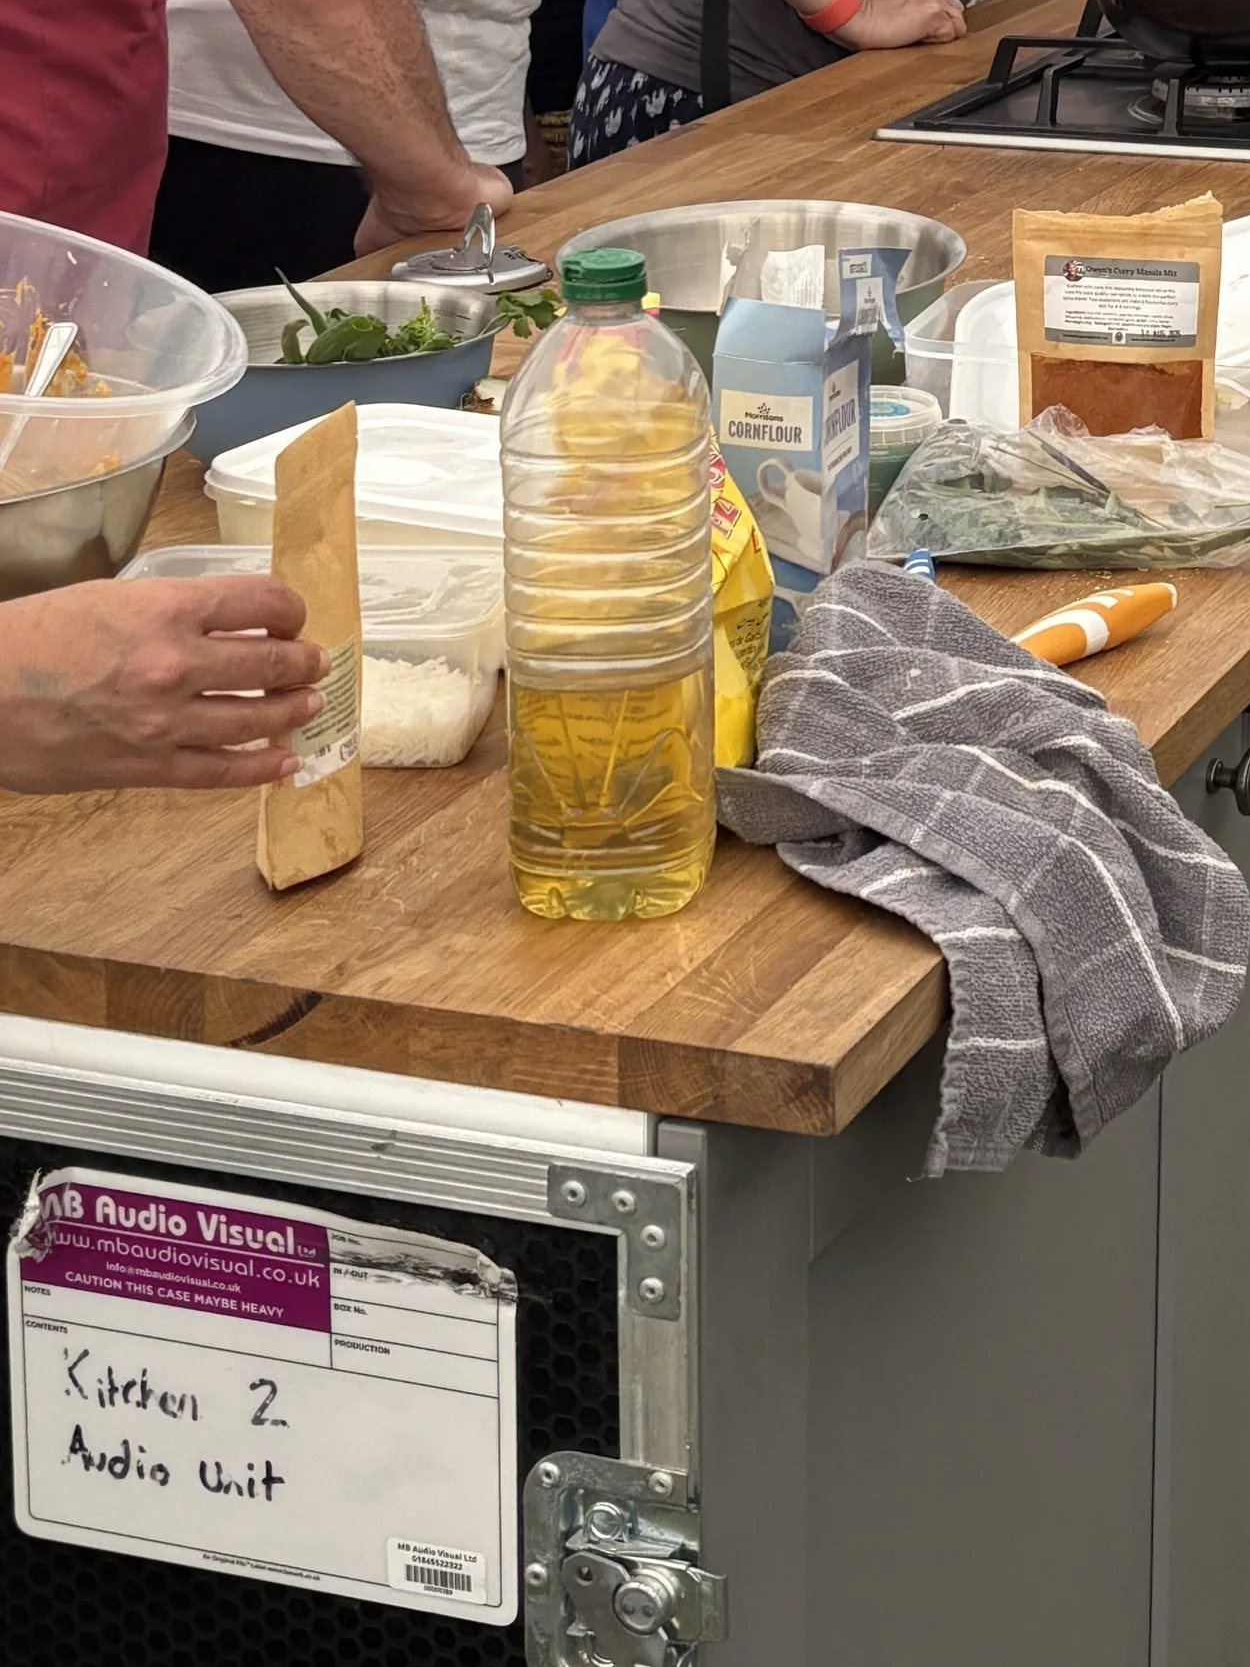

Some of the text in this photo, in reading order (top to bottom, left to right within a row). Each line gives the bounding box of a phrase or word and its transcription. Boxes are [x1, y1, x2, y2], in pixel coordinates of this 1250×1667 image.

[745, 411, 784, 422] Morrisons
[728, 420, 802, 444] CORNFLOUR
[95, 1195, 187, 1237] Audio
[197, 1210, 295, 1255] Visual
[331, 1234, 346, 1242] JOB
[24, 1286, 51, 1296] NOTES
[65, 1271, 284, 1318] CAUTION THIS CASE MAYBE HEAVY
[334, 1303, 351, 1312] BOX
[26, 1320, 68, 1334] CONTENTS
[334, 1339, 390, 1355] PRODUCTION
[64, 1348, 289, 1428] Kitchen 2
[61, 1424, 285, 1502] Audio Unit
[397, 1543, 477, 1563] MB Audio Visual Ltd
